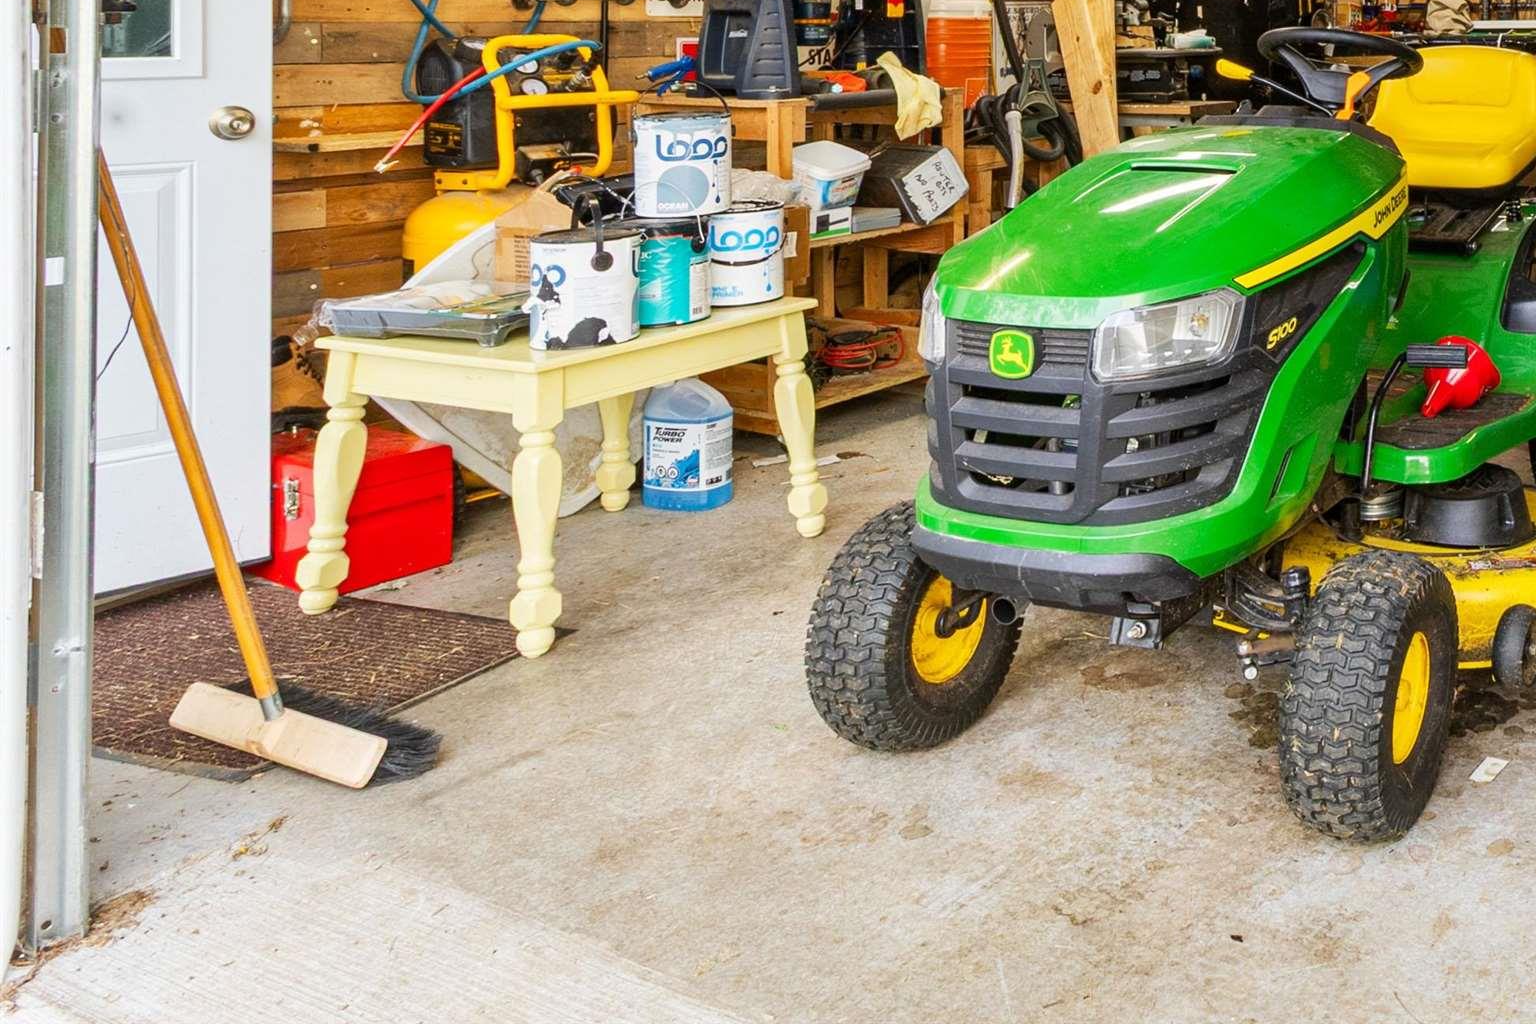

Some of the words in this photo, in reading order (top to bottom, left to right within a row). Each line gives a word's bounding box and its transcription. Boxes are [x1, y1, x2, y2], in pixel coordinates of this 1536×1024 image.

[1373, 207, 1392, 227] JOHN
[1391, 186, 1406, 212] DEERE
[1266, 317, 1297, 349] S100
